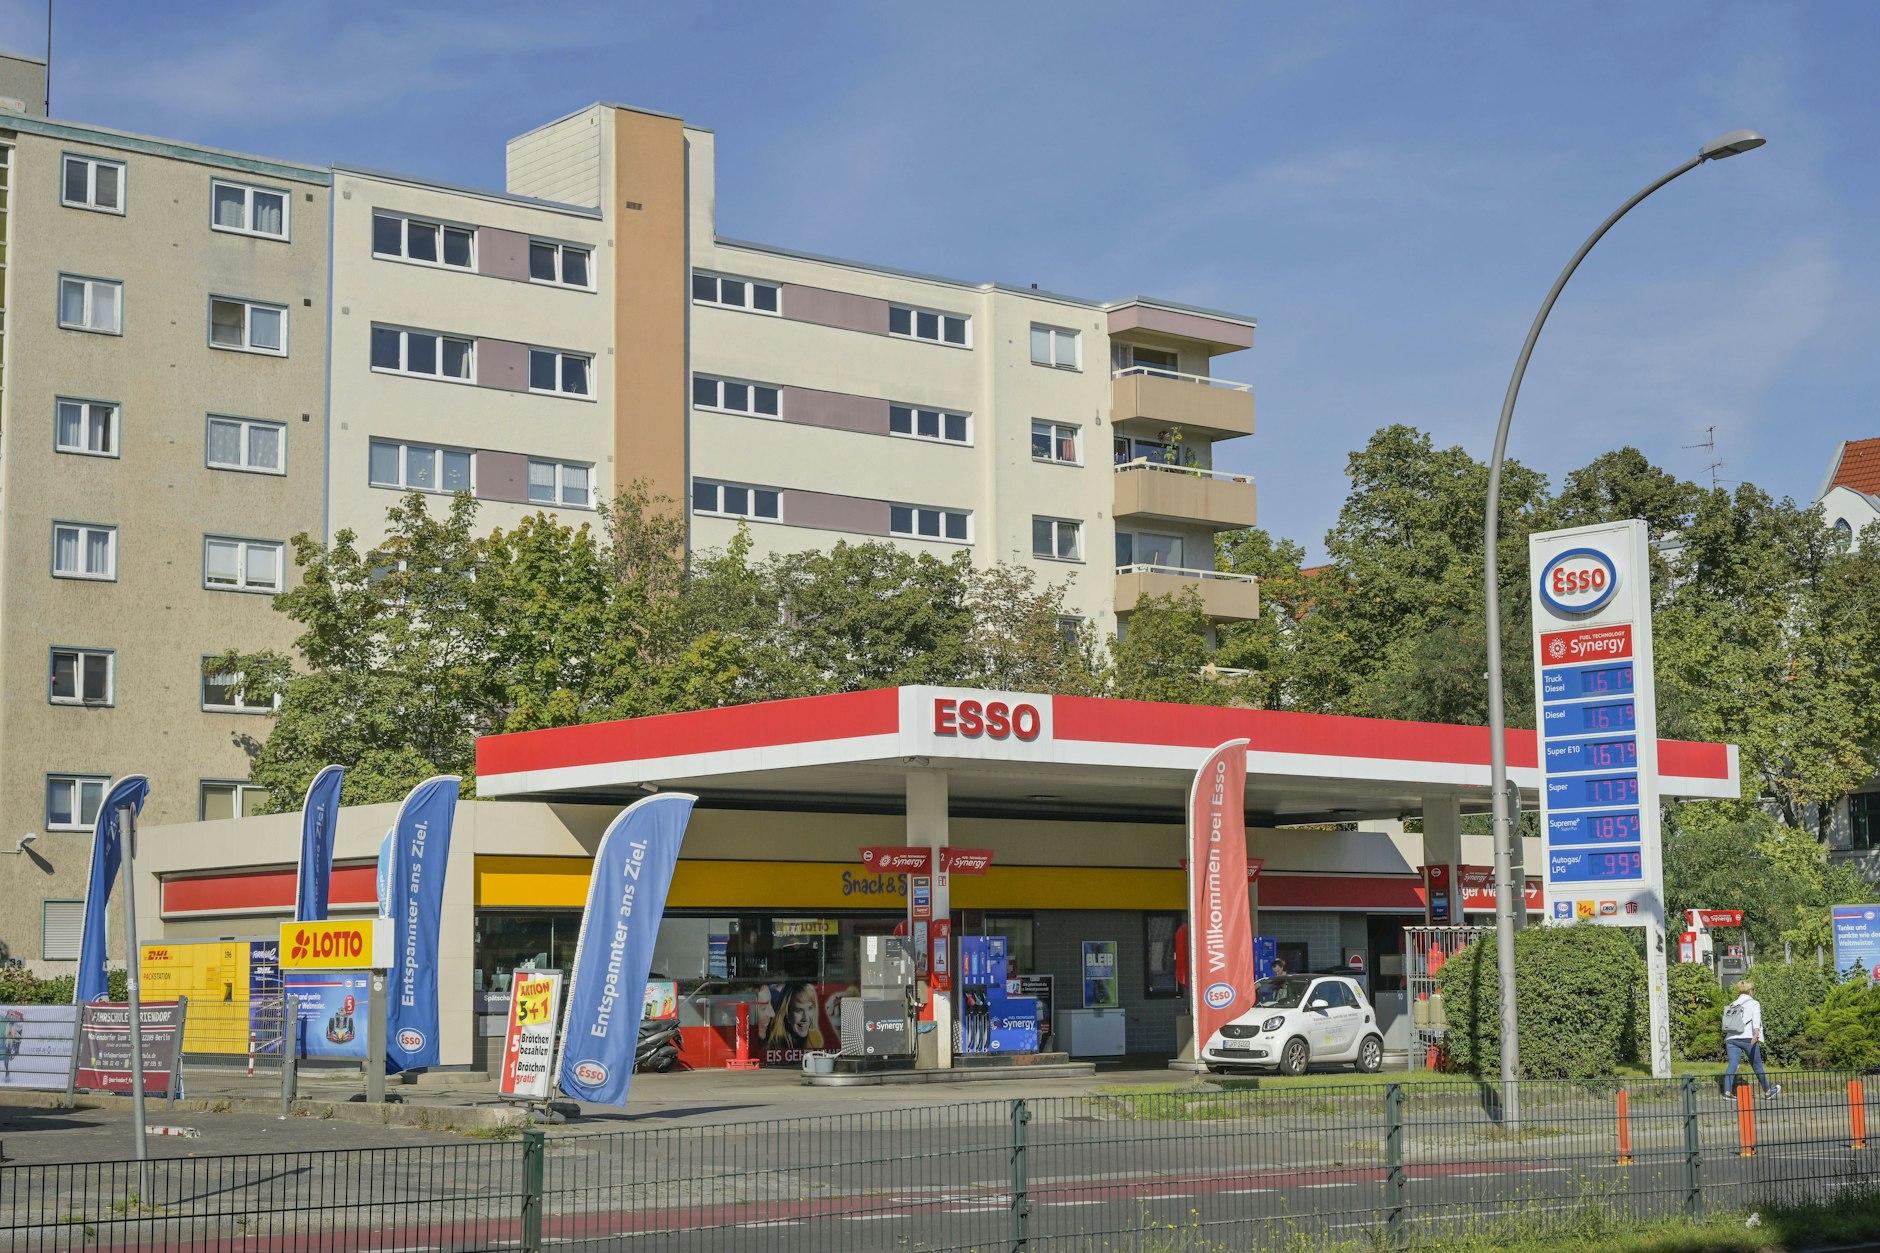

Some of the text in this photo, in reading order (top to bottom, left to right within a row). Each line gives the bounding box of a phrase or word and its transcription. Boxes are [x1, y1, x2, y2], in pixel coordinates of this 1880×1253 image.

[1553, 567, 1605, 593] Esso
[1592, 631, 1625, 639] TECHNOLOGY
[1570, 638, 1625, 657] Synergy
[1544, 675, 1563, 683] Truck
[1545, 684, 1565, 693] Diesel
[934, 698, 1041, 740] ESSO
[1545, 710, 1566, 719] Diesel
[1547, 747, 1566, 756] Super
[1568, 746, 1580, 754] E10
[1211, 761, 1226, 806] Esso
[1549, 779, 1638, 802] Super 1.739
[1210, 812, 1222, 843] bei
[412, 820, 428, 859] Ziel.
[624, 839, 648, 881] Ziel.
[892, 857, 925, 868] Synergy
[940, 853, 945, 862] 2
[954, 858, 986, 869] Synergy
[1552, 855, 1582, 865] Autogas/
[1552, 866, 1566, 874] LPG
[411, 864, 421, 893] ans
[842, 870, 884, 896] Snack
[886, 876, 897, 894] &
[1463, 873, 1487, 883] Synergy
[621, 887, 635, 918] ans
[1206, 848, 1226, 973] Willkommen
[313, 931, 363, 958] LOTTO
[148, 951, 169, 960] DHL
[402, 901, 418, 1007] Entspannter
[1086, 953, 1113, 967] BLEIB
[591, 924, 628, 1038] Entspannter
[520, 982, 550, 997] AKTION
[1209, 991, 1230, 1001] Esso
[92, 1011, 172, 1023] FAHRSCHULE RIENDORF
[876, 1021, 904, 1032] Synergy
[1003, 1018, 1035, 1031] Synergy
[401, 1035, 421, 1045] Esso
[511, 1035, 520, 1052] 5
[521, 1033, 549, 1044] Brötchen
[520, 1045, 548, 1056] bezahlen
[766, 1050, 782, 1062] EIS
[510, 1060, 515, 1078] 1
[518, 1061, 546, 1072] Brötchen
[578, 1066, 604, 1081] Esso
